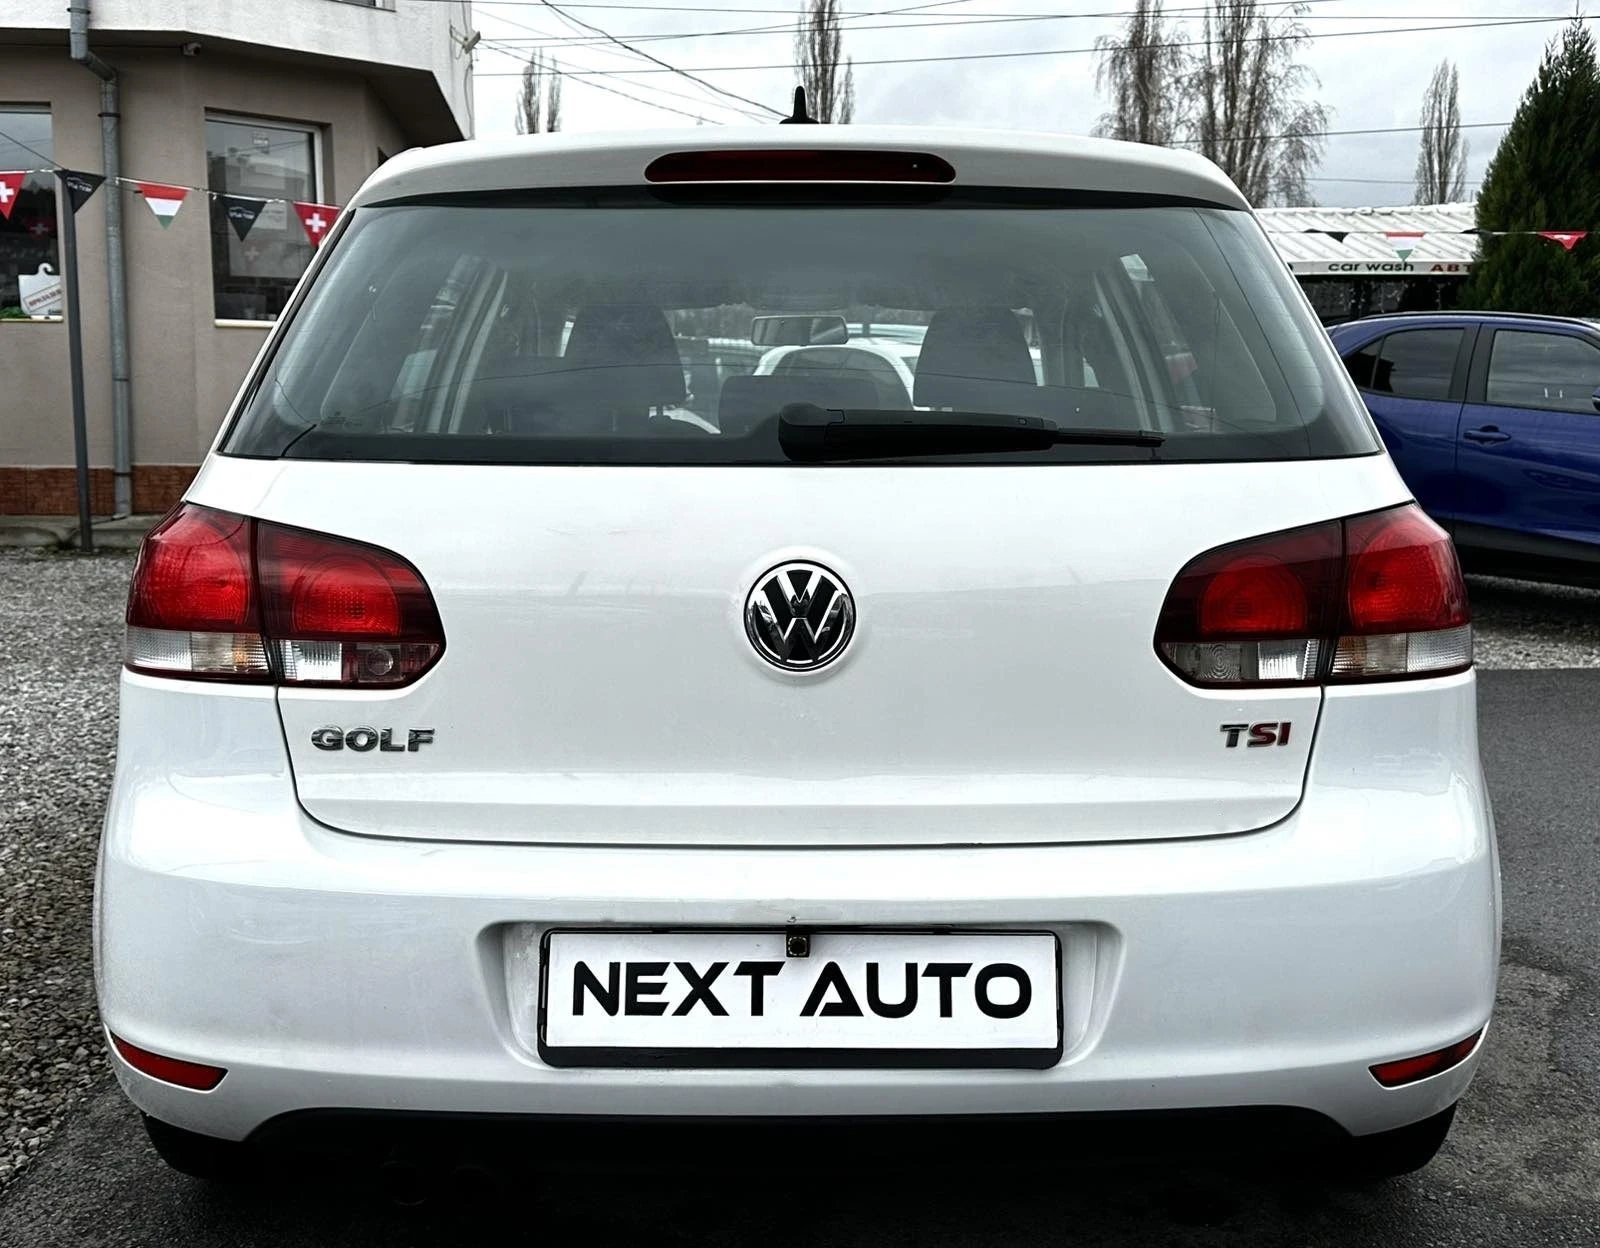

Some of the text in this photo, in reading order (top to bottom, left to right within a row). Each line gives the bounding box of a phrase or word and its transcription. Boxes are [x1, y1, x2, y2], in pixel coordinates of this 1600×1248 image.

[1328, 261, 1414, 272] car wash
[311, 726, 435, 752] GOLF
[1220, 722, 1291, 748] TSI
[572, 961, 1032, 1019] NEXT AUTO
